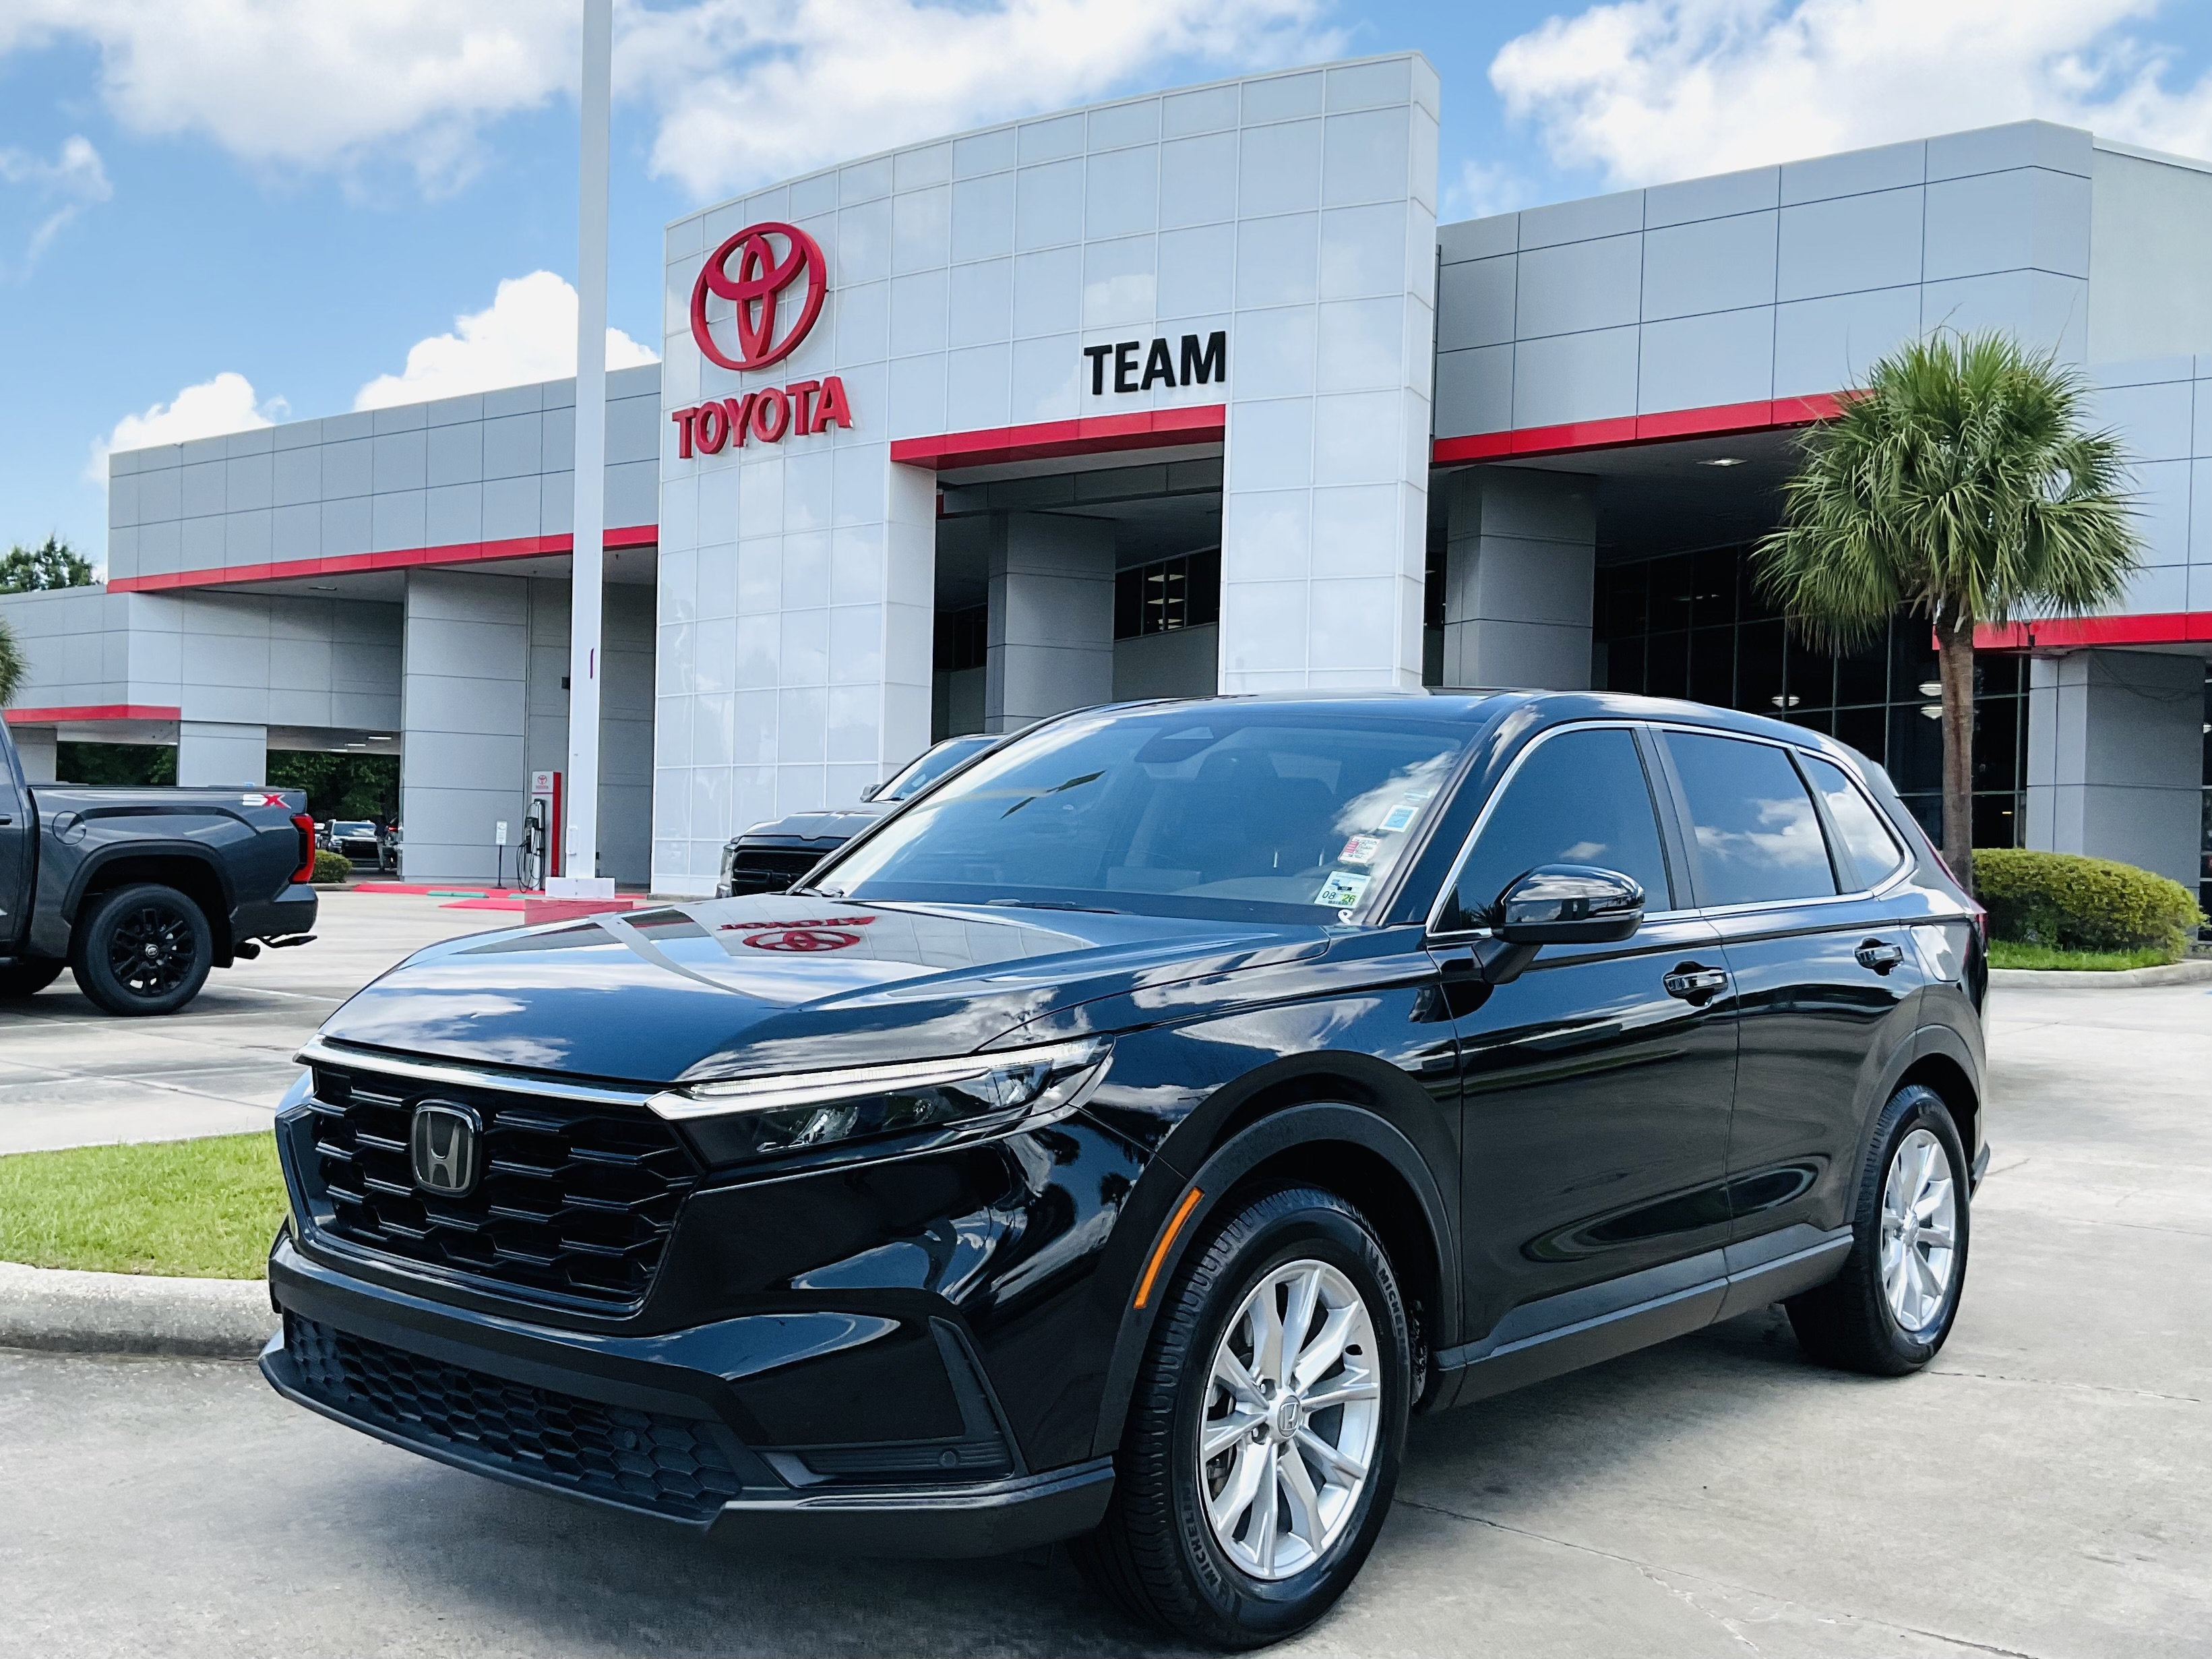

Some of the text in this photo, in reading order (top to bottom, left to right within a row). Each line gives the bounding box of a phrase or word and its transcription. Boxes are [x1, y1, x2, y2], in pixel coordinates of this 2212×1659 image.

[1084, 330, 1226, 395] TEAM
[672, 376, 852, 458] TOYOTA
[1322, 891, 1356, 905] 08 26
